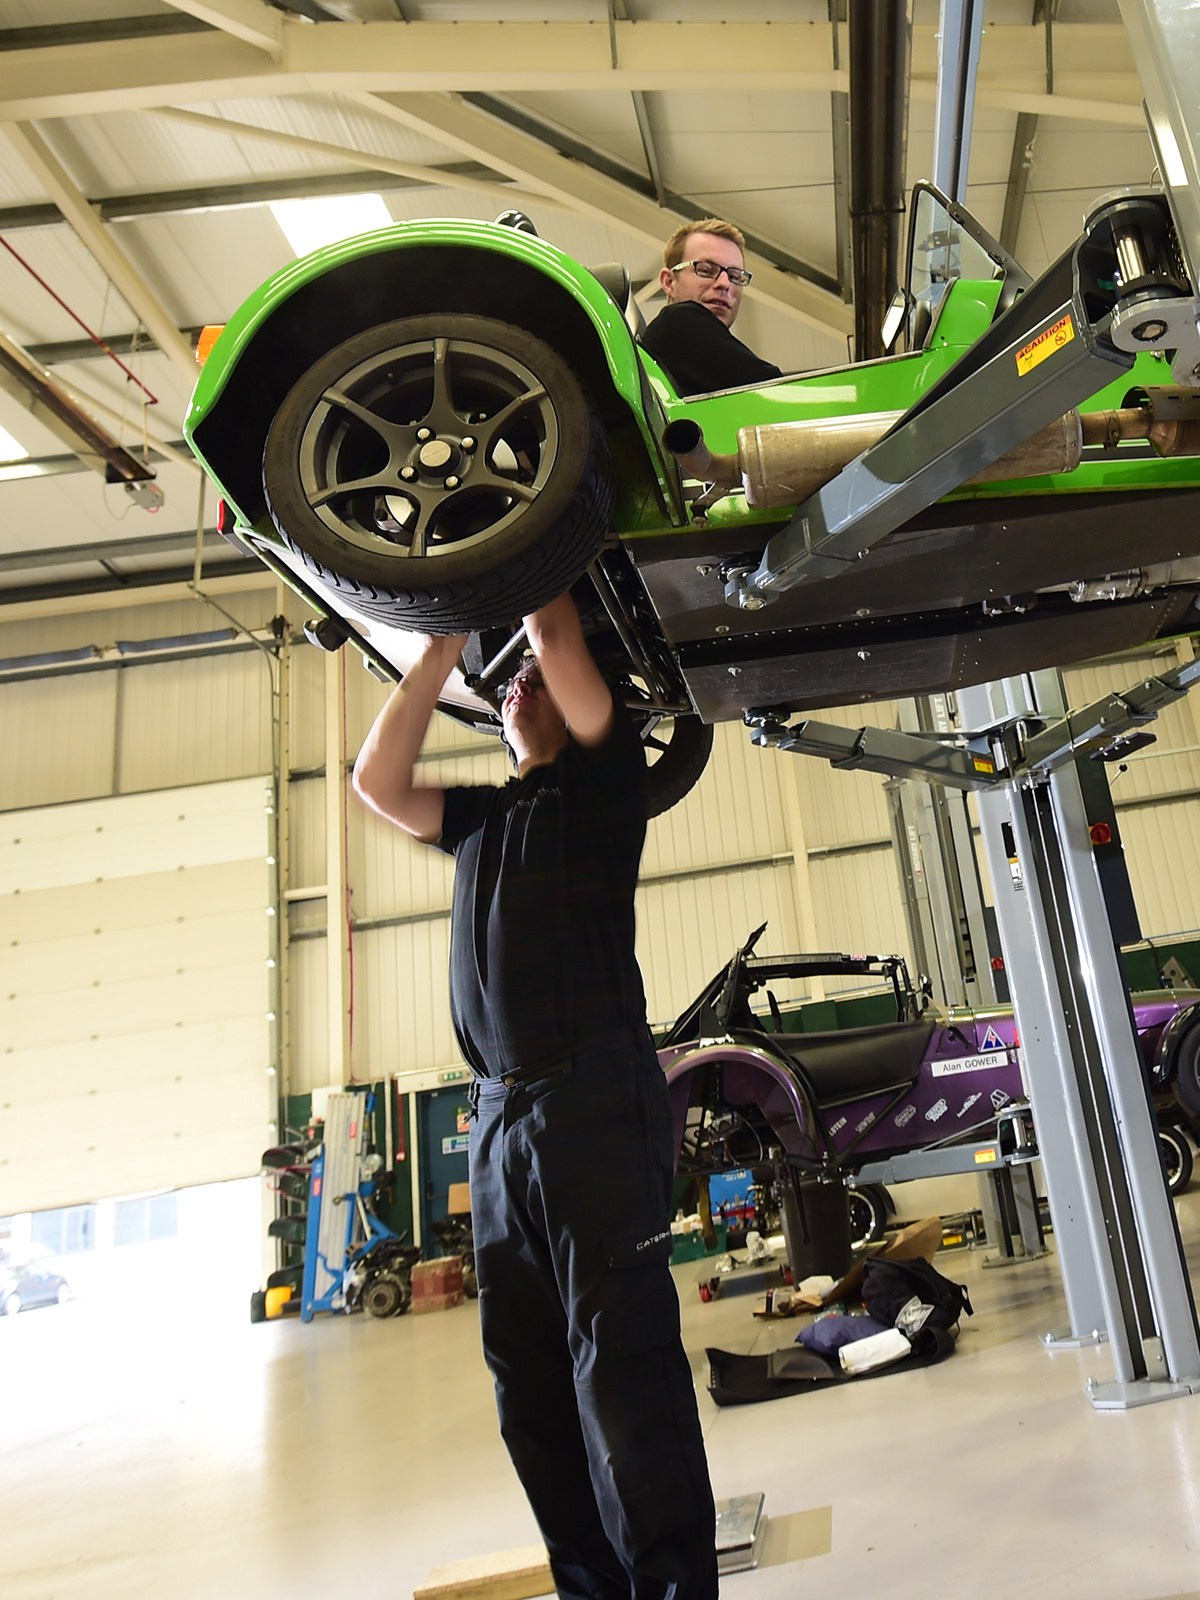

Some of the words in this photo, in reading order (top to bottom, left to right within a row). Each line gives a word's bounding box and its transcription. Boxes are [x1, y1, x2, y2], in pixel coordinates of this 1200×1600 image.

[1025, 319, 1066, 354] CAUTION
[934, 697, 946, 719] LIFT
[943, 1063, 961, 1072] Alan
[964, 1056, 998, 1069] GOWER
